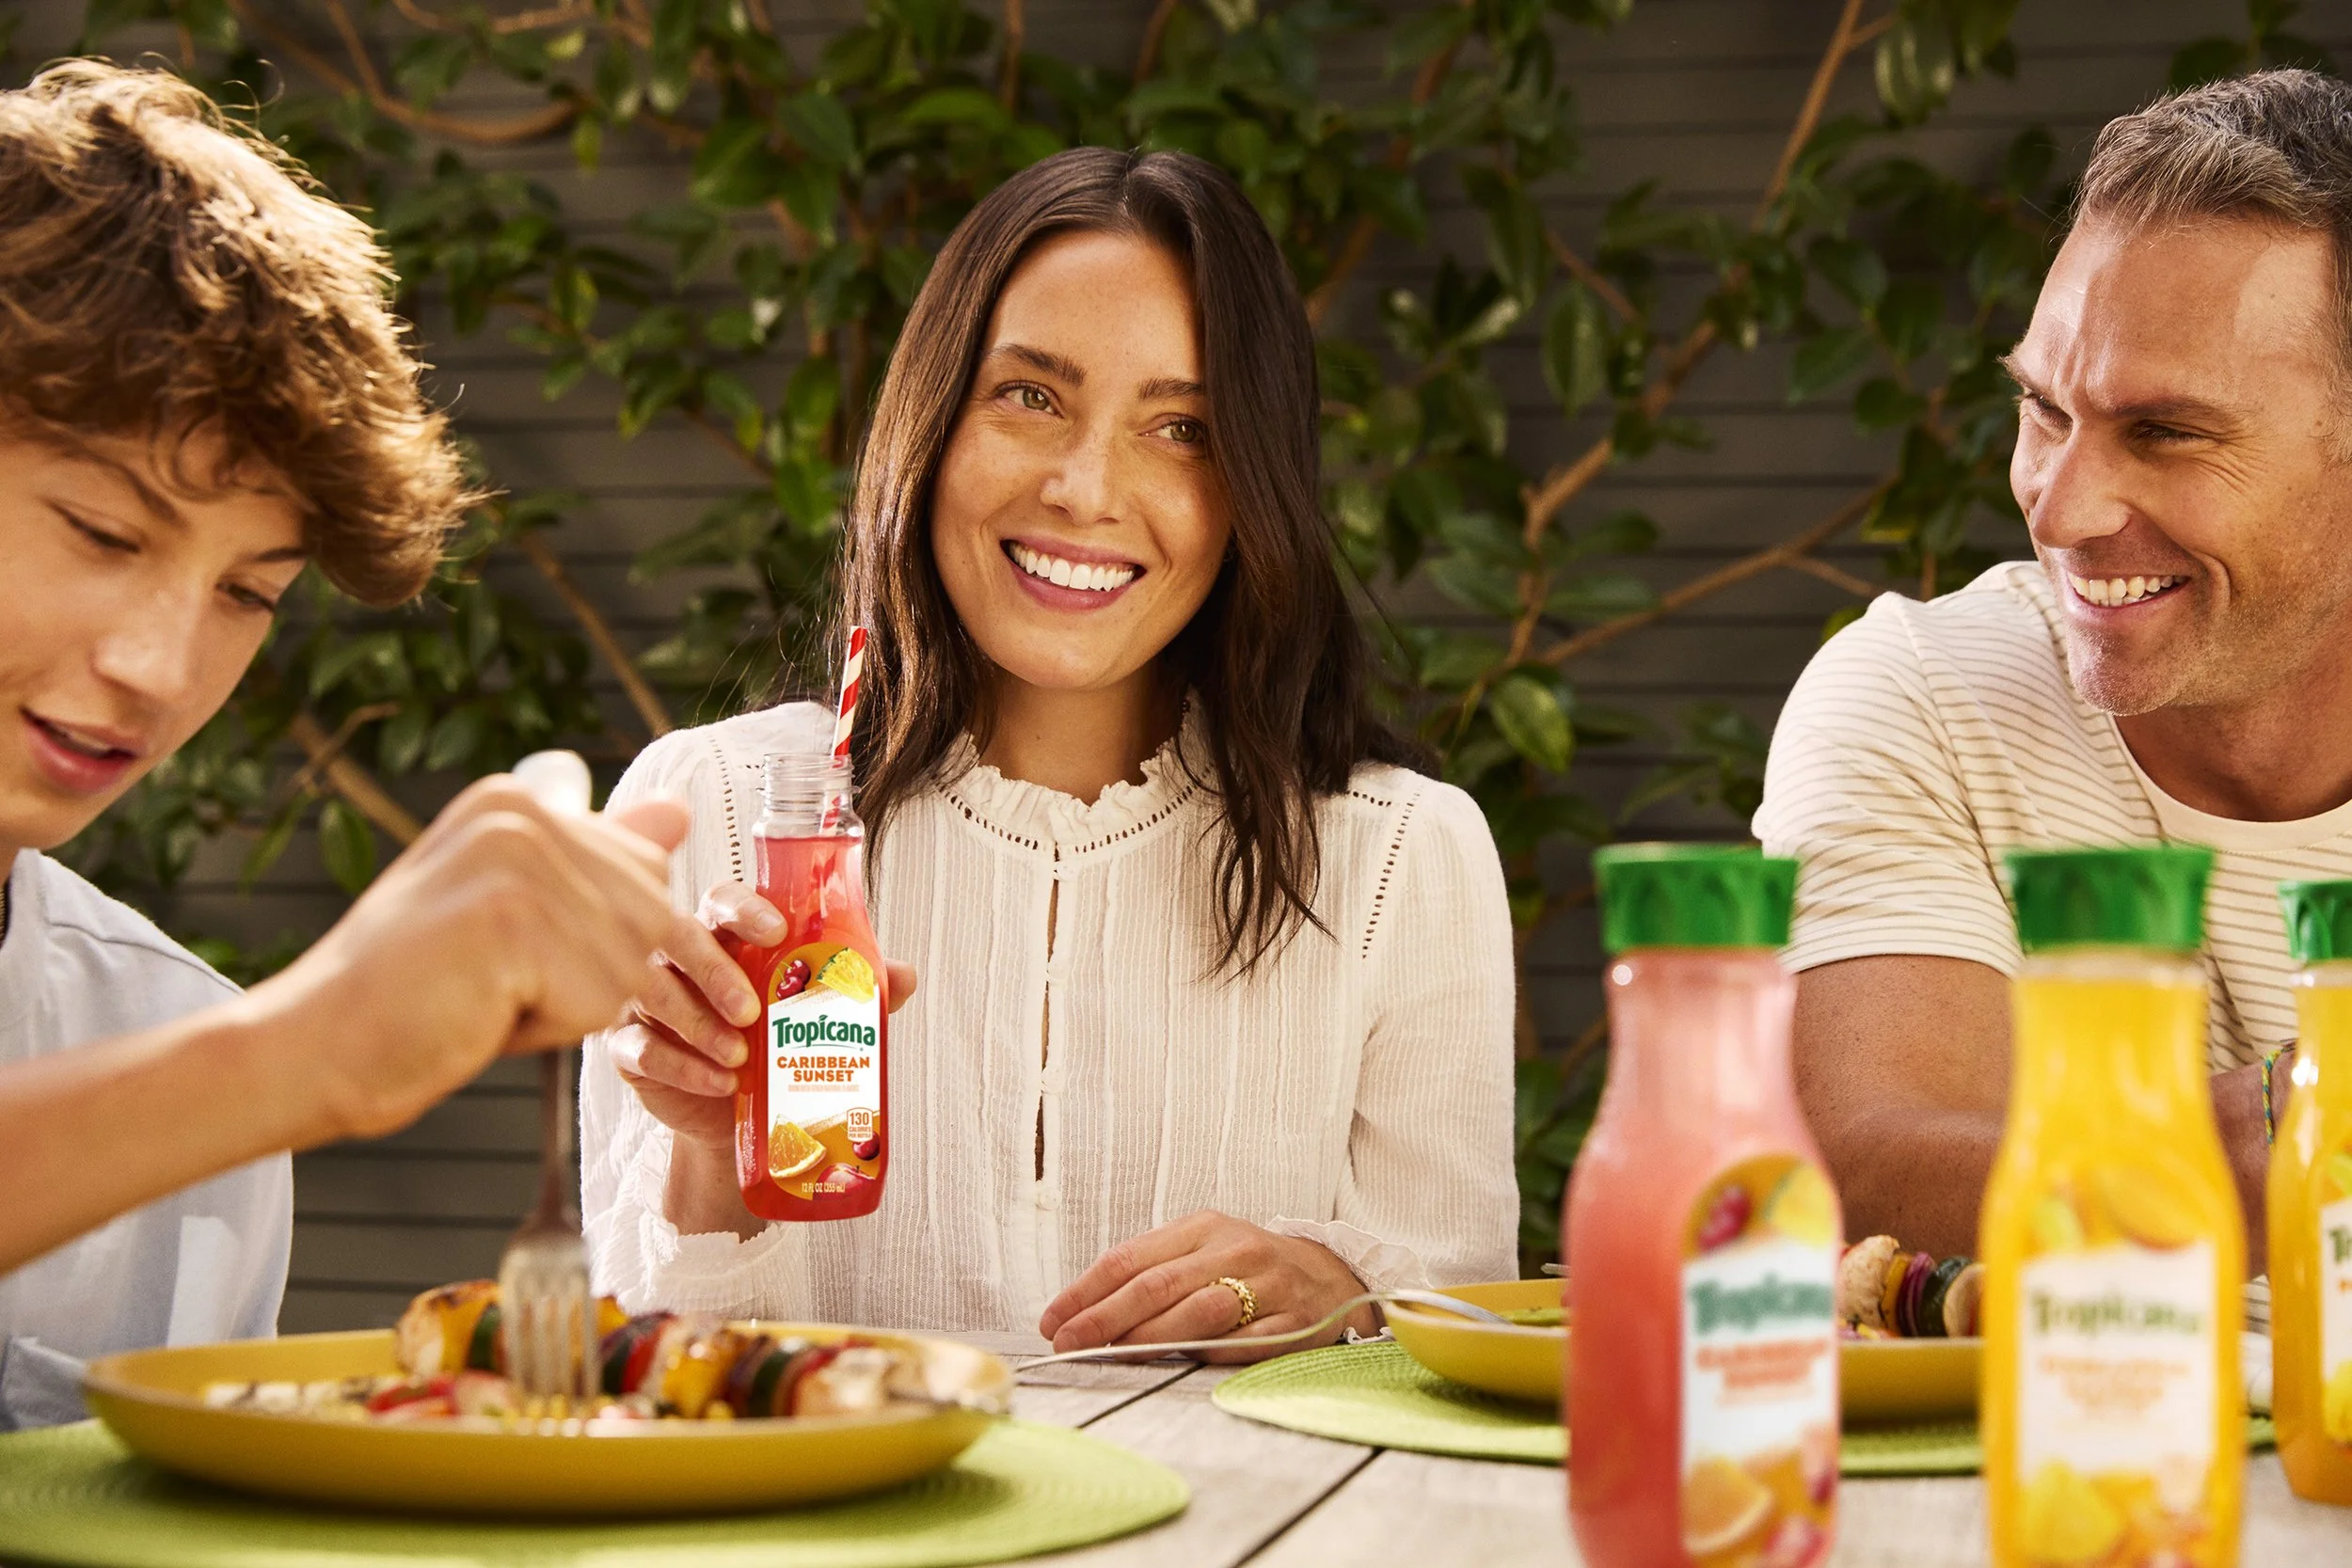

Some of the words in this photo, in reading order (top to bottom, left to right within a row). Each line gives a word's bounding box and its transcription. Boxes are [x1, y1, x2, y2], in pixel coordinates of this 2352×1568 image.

[771, 1014, 876, 1048] Tropicana
[776, 1055, 870, 1069] CARIBBEAN
[793, 1069, 854, 1082] SUNSET
[849, 1112, 869, 1126] 130
[815, 1181, 823, 1194] OZ
